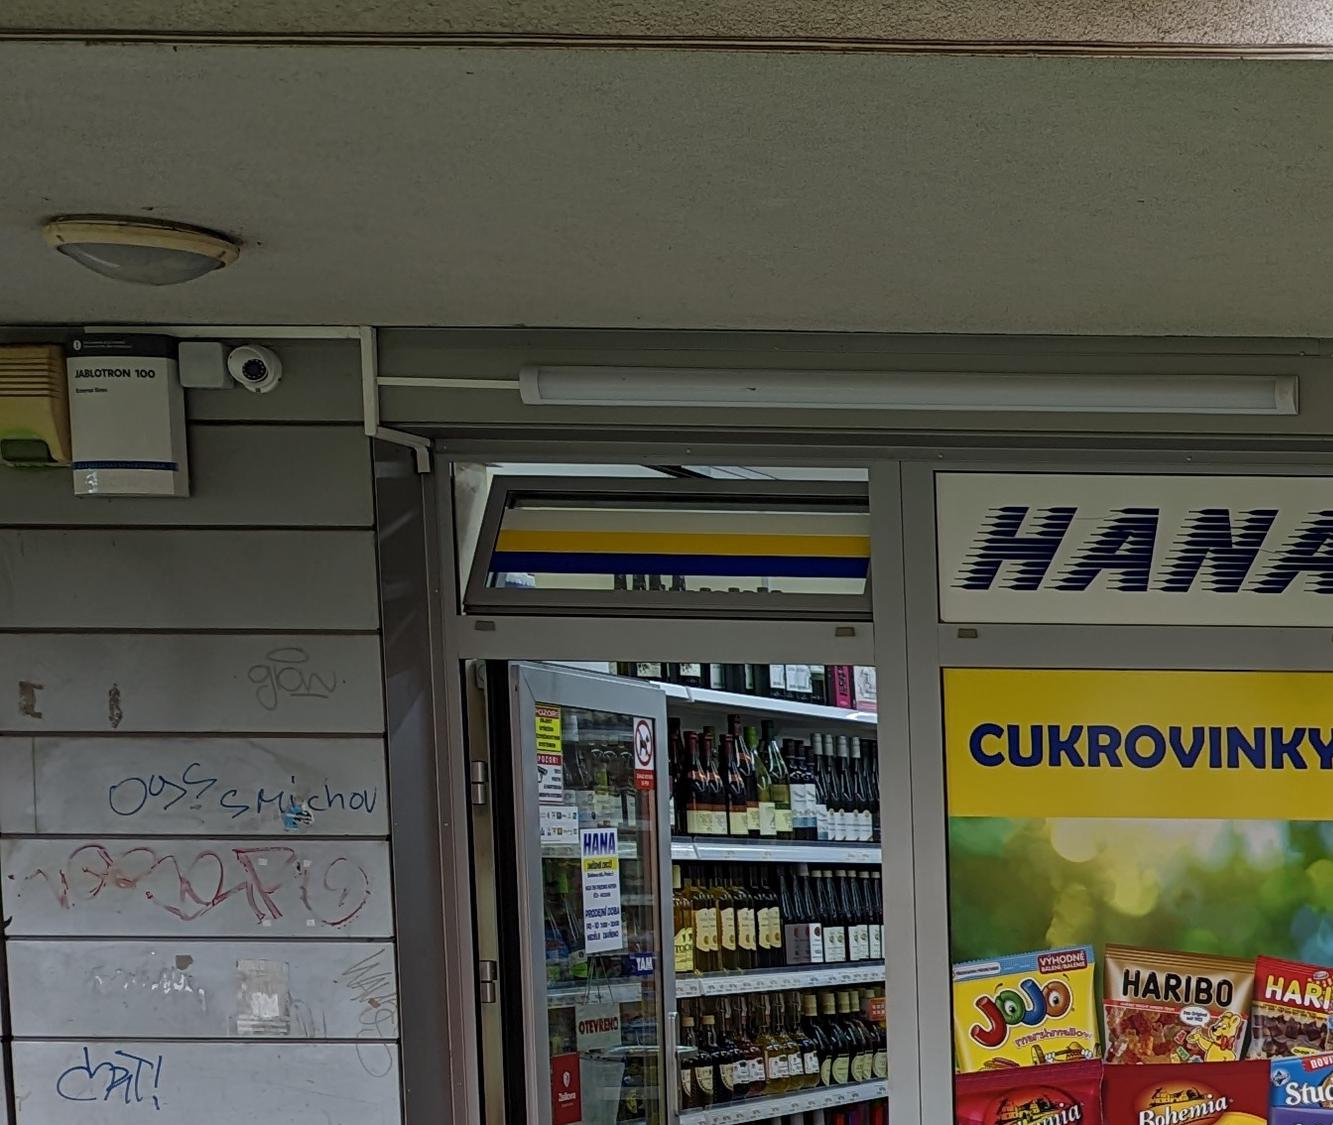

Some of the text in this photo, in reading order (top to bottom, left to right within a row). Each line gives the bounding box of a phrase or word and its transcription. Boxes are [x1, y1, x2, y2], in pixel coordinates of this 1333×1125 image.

[75, 368, 156, 378] JABLOTRON 100
[583, 832, 616, 856] HANA
[1039, 952, 1086, 966] VÝHODNÉ
[1122, 968, 1233, 1007] HARIBO
